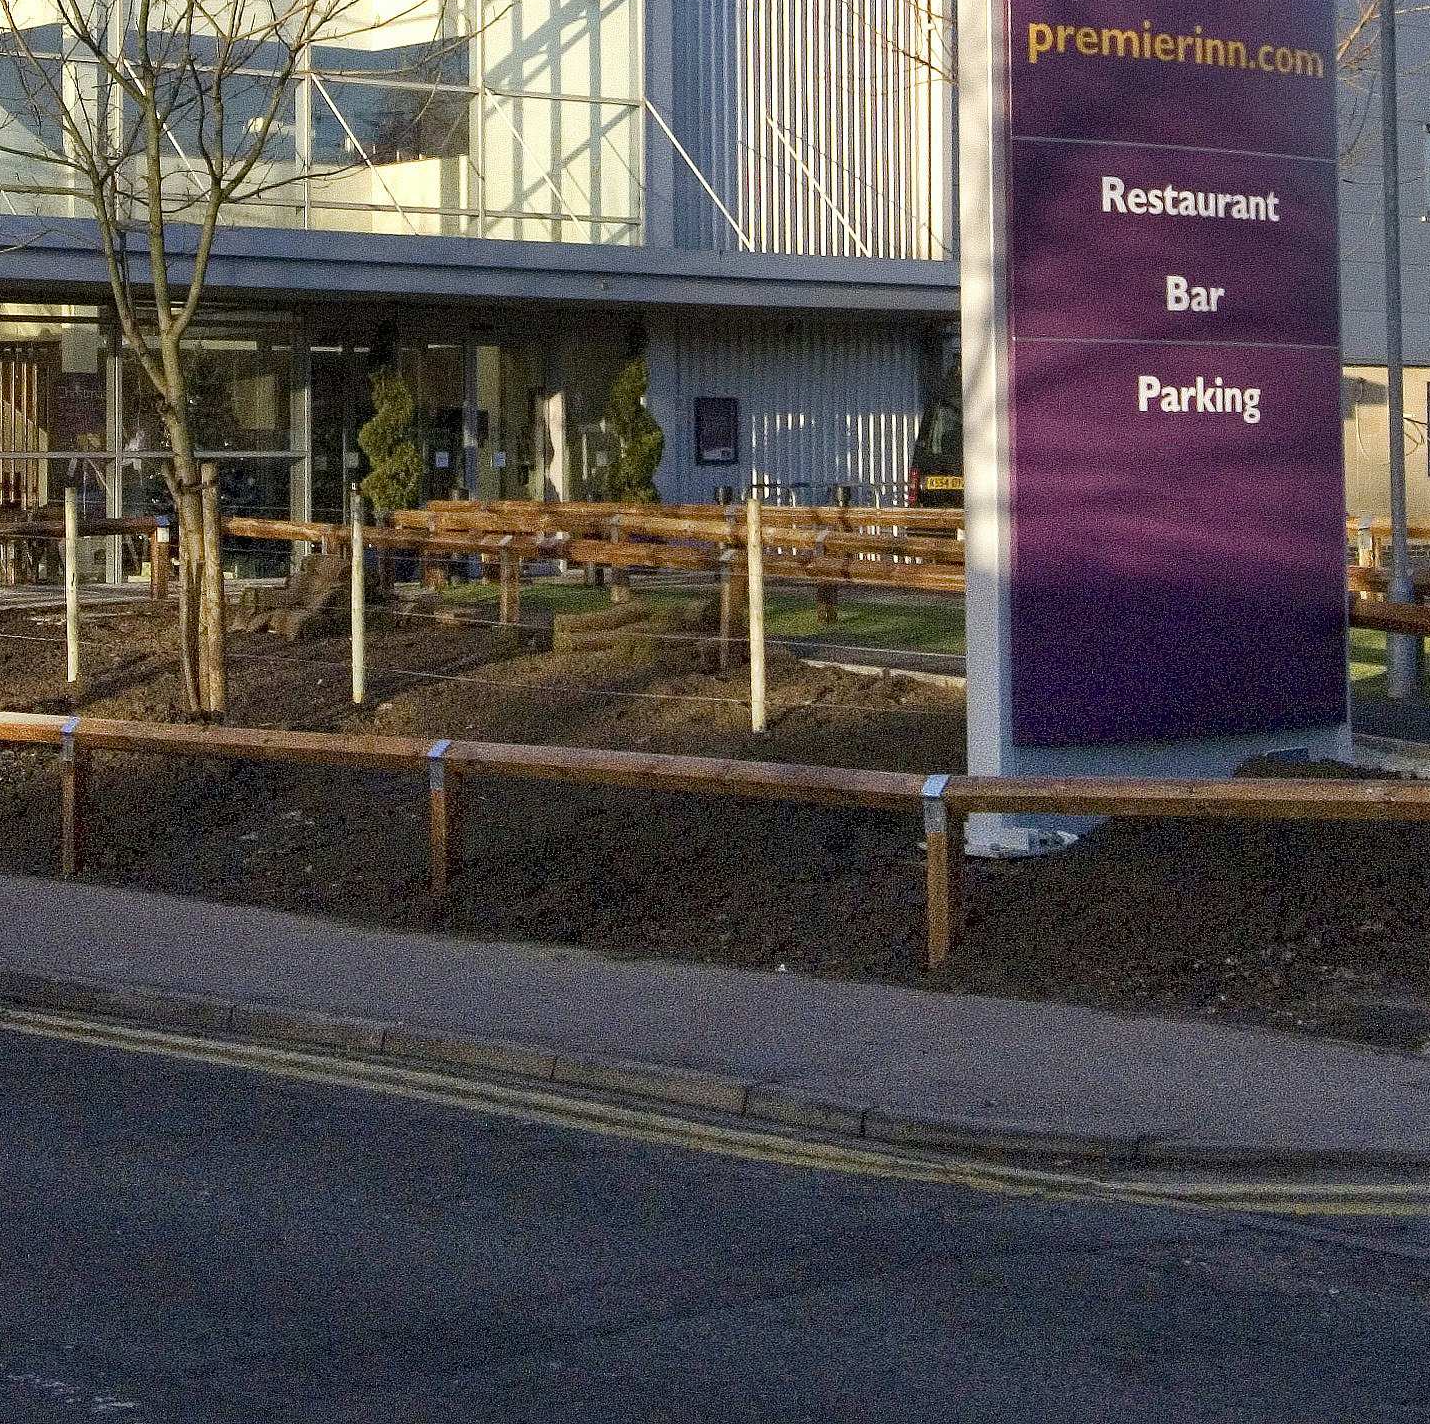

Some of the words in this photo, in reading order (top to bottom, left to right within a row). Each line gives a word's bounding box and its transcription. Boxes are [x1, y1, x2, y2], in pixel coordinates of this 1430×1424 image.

[1027, 19, 1325, 79] premierinn.com
[1101, 176, 1280, 222] Restaurant
[1166, 275, 1225, 313] Bar
[1137, 374, 1261, 425] Parking
